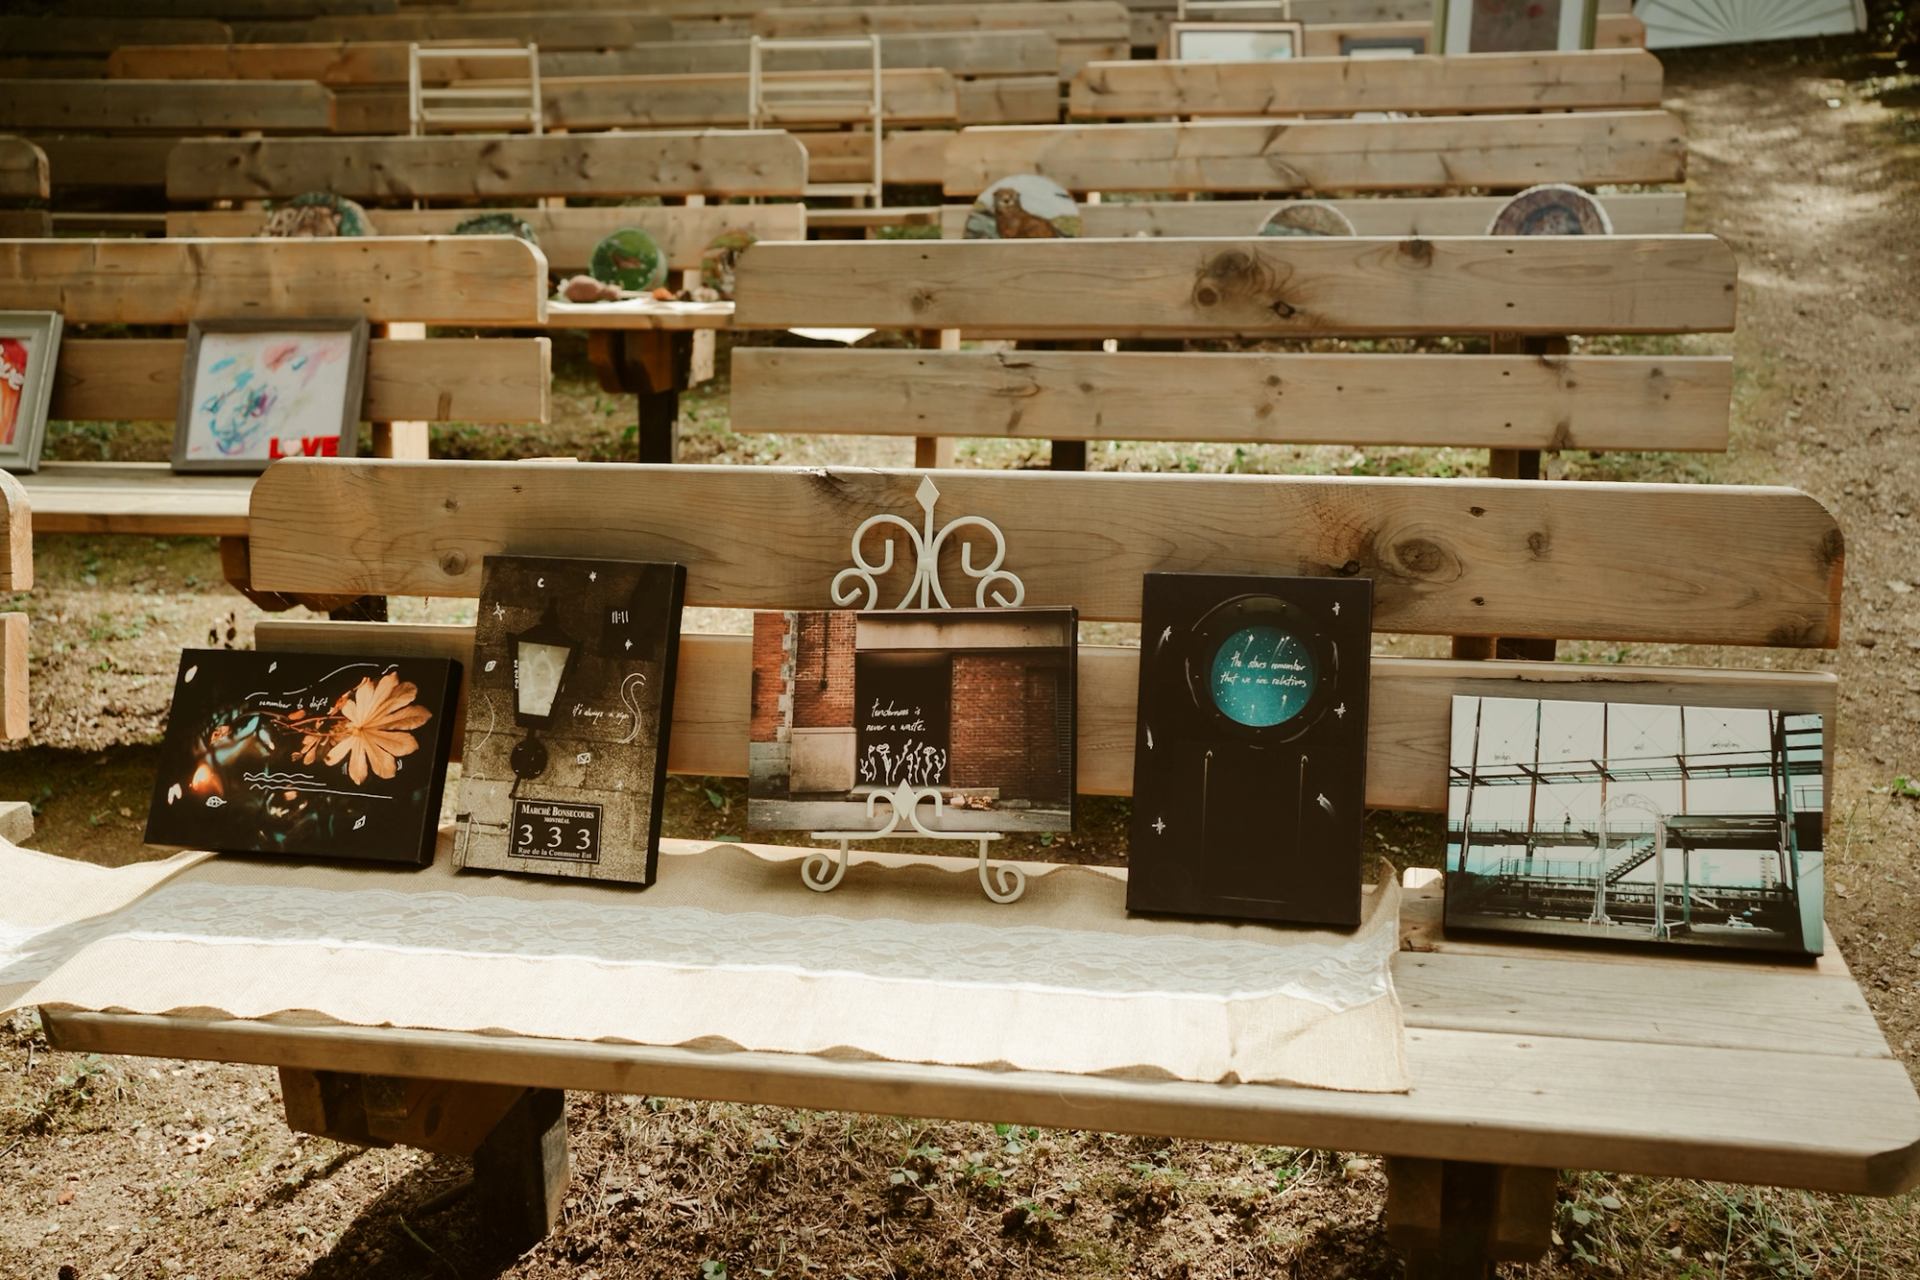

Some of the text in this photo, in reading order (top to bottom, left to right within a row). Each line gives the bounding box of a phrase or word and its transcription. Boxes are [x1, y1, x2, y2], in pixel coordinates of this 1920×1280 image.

[1247, 655, 1267, 669] stars
[1271, 659, 1306, 671] remember
[1220, 671, 1240, 686] that
[1271, 675, 1307, 688] relatives
[259, 696, 328, 711] remember to drift
[914, 706, 921, 716] is
[552, 806, 594, 819] BONSECOURS
[518, 847, 531, 855] Rue
